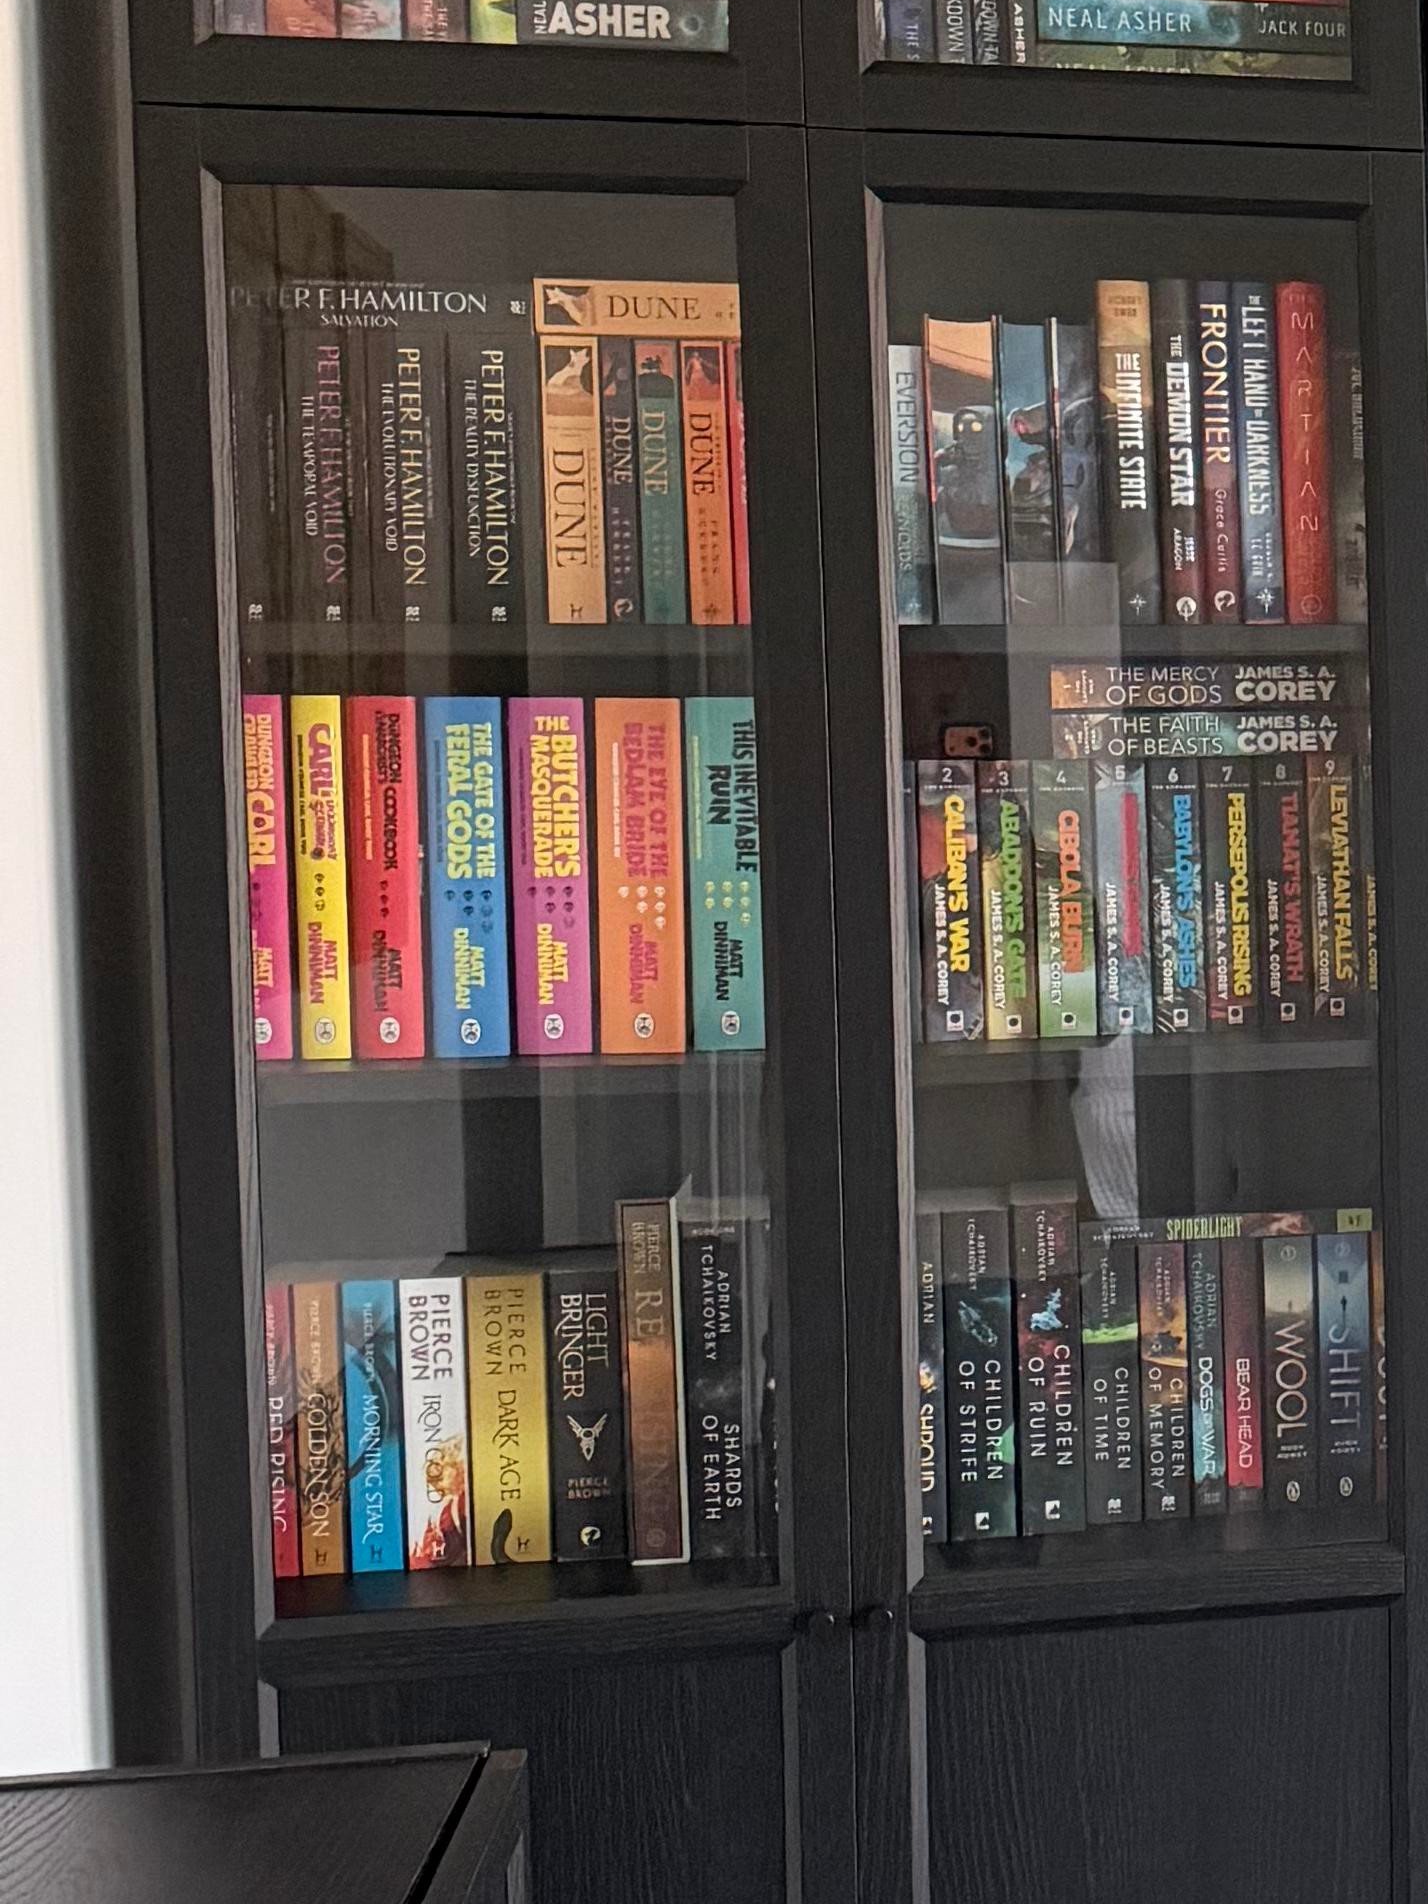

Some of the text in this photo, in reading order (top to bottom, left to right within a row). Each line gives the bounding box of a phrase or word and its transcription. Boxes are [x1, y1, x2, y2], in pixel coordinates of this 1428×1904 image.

[534, 1, 547, 35] NEAL
[1258, 20, 1347, 37] JACK FOUR
[321, 315, 398, 328] SALVATION
[343, 289, 487, 313] HAMILTON
[609, 296, 700, 320] DUNE
[1200, 303, 1230, 464] FRONTIER
[641, 412, 667, 494] DUNE
[690, 413, 713, 495] DUNE
[402, 449, 427, 585] HAMILTON
[1147, 686, 1222, 704] GODS
[1151, 667, 1219, 682] MERCY
[1235, 681, 1336, 701] COREY
[1145, 738, 1223, 755] BEASTS
[1158, 716, 1220, 733] FAITH
[708, 765, 731, 825] RUIN
[447, 799, 472, 879] GODS
[409, 1297, 429, 1381] BROWN
[432, 1294, 453, 1380] PIERCE
[1275, 1320, 1308, 1438] WOOL
[1329, 1327, 1360, 1428] SHIFT
[493, 1390, 520, 1501] DARK AGE
[725, 1424, 741, 1508] SHARDS
[960, 1406, 977, 1482] STRIFE
[703, 1453, 720, 1521] EARTH
